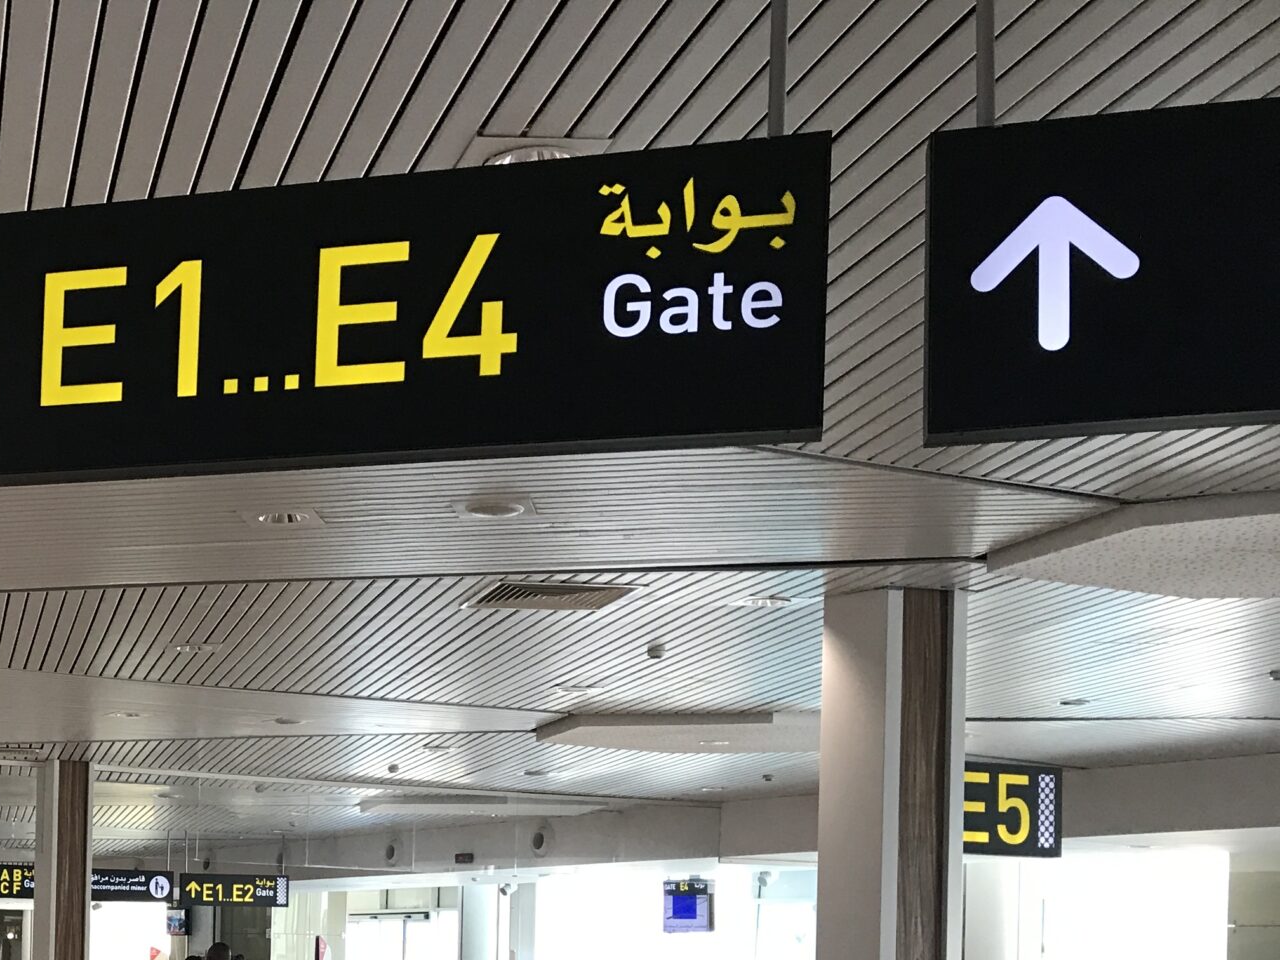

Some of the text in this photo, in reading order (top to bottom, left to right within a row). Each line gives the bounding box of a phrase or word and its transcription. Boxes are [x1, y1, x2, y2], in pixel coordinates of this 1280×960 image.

[598, 176, 797, 260] بوابة
[602, 271, 784, 339] Gate
[962, 771, 1031, 845] E5
[0, 868, 22, 882] A B
[0, 881, 22, 895] C F
[23, 879, 35, 889] Ga
[255, 877, 276, 888] بوابة
[255, 888, 275, 897] Gate
